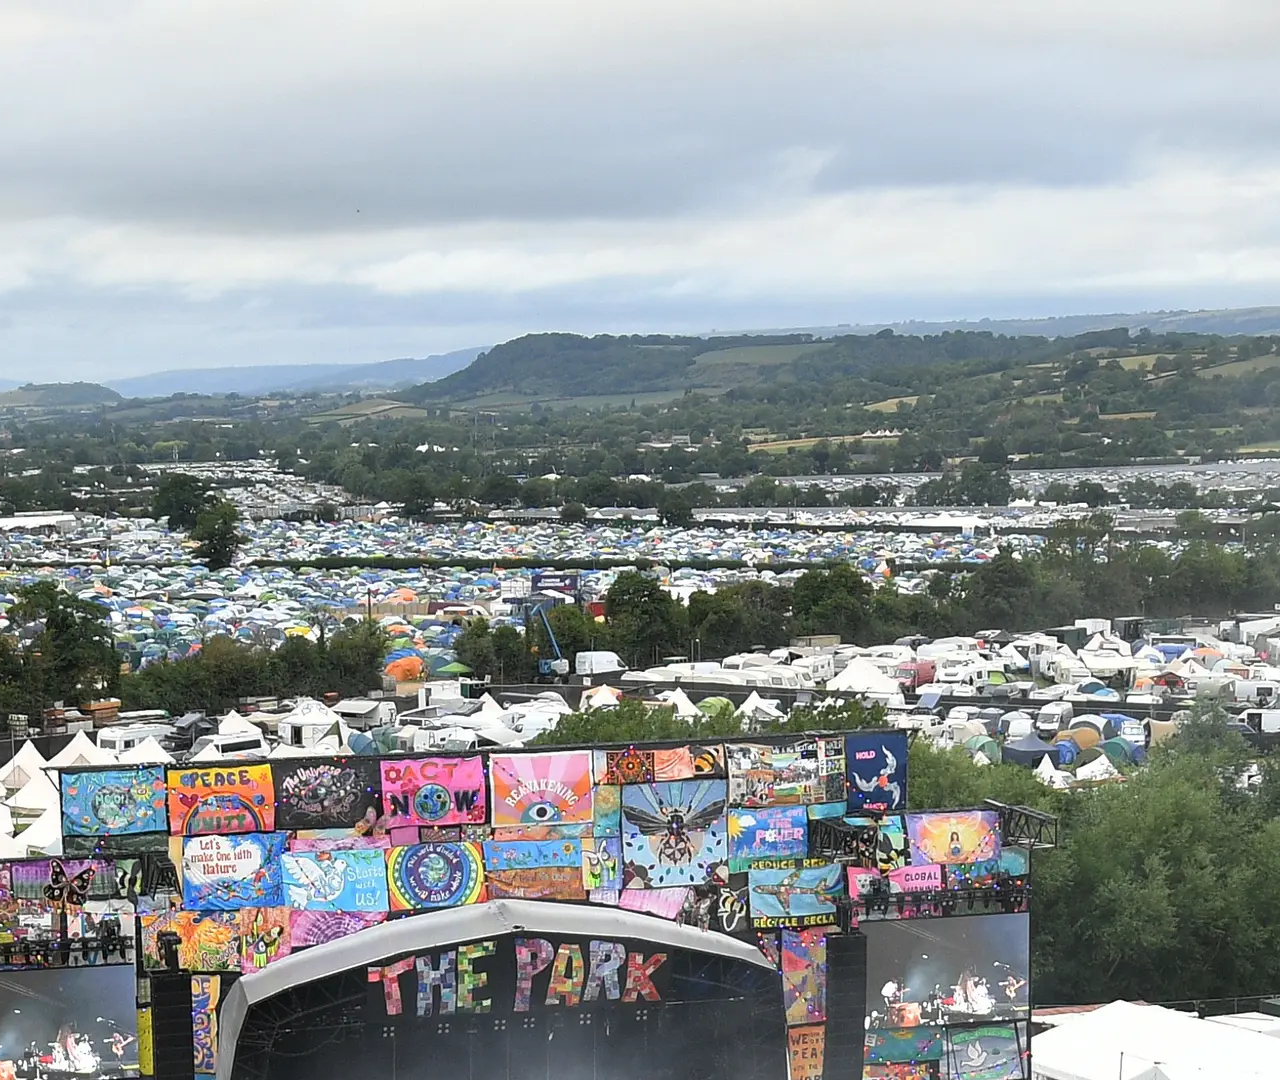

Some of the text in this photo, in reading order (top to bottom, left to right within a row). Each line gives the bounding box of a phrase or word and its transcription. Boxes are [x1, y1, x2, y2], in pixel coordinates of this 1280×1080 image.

[855, 750, 876, 760] HOLD
[402, 762, 458, 781] ACT
[190, 770, 251, 788] PEACE
[282, 774, 299, 793] The
[505, 778, 579, 807] REAWAKENING
[199, 838, 221, 850] Let's
[191, 852, 214, 862] make
[216, 852, 231, 862] One
[203, 863, 238, 876] Nature
[751, 860, 796, 870] REDUCE
[347, 866, 384, 882] Starts
[904, 871, 939, 882] GLOBAL
[355, 880, 377, 889] with
[753, 914, 835, 928] RECYCLE RECLA
[367, 937, 668, 1017] THE PARK
[791, 1033, 809, 1045] WE
